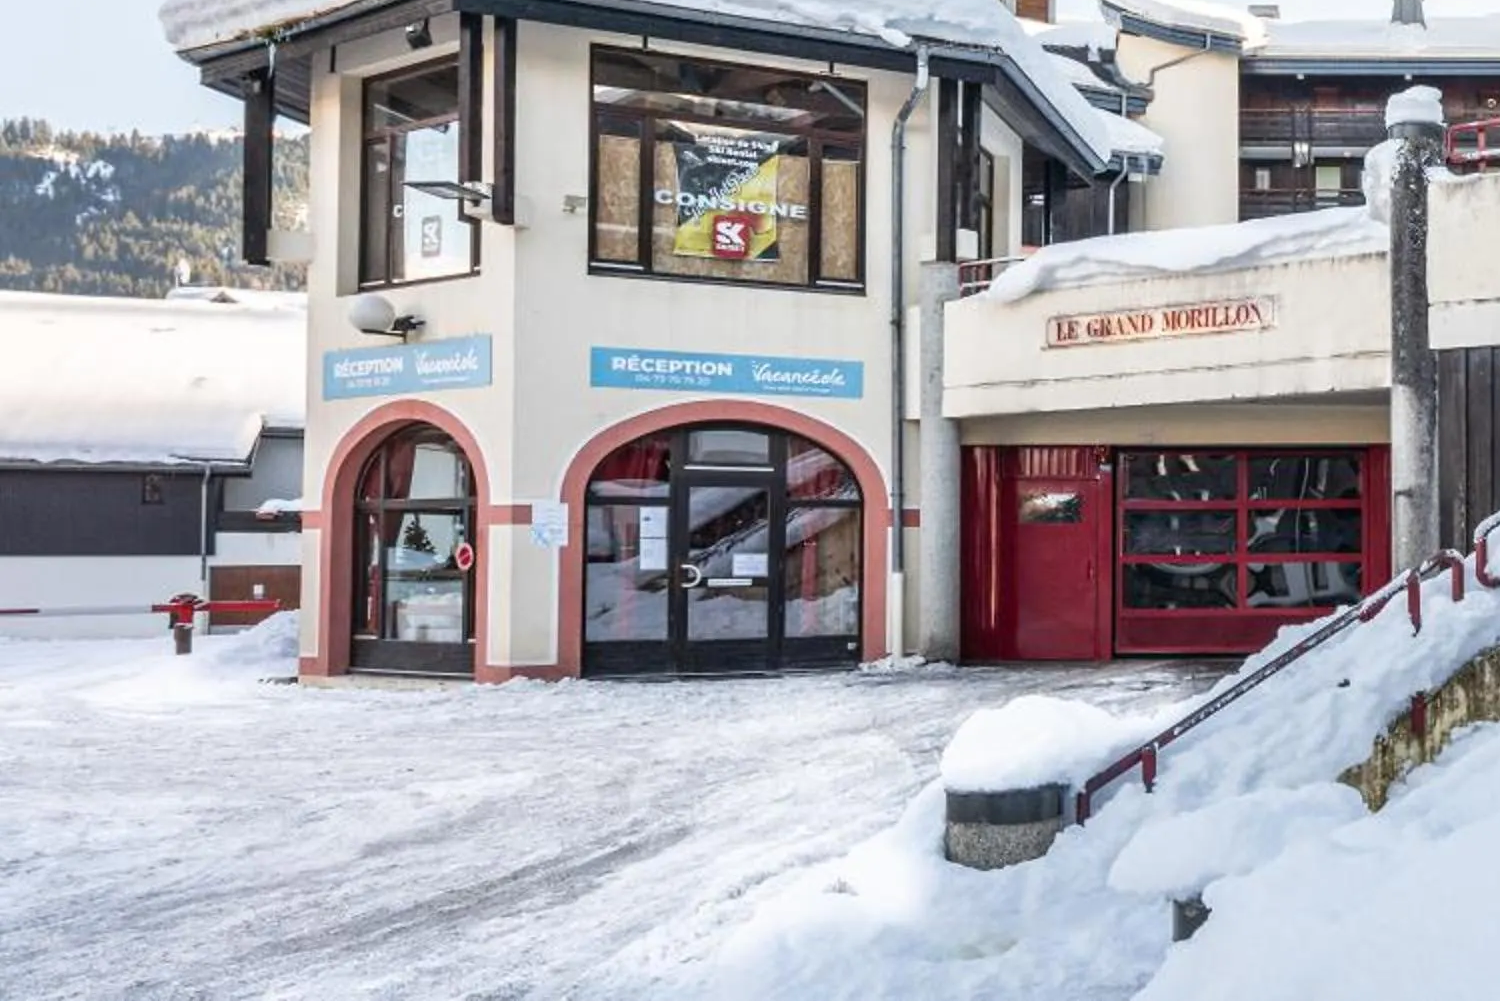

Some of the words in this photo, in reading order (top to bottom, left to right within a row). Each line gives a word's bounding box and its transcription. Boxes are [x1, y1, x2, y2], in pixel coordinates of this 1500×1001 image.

[654, 189, 808, 219] CONSIGNE
[1056, 320, 1078, 342] LE
[1087, 314, 1153, 338] GRAND
[1161, 302, 1263, 332] MORILLON
[333, 356, 404, 378] RÉCEPTION
[611, 354, 733, 376] RÉCEPTION
